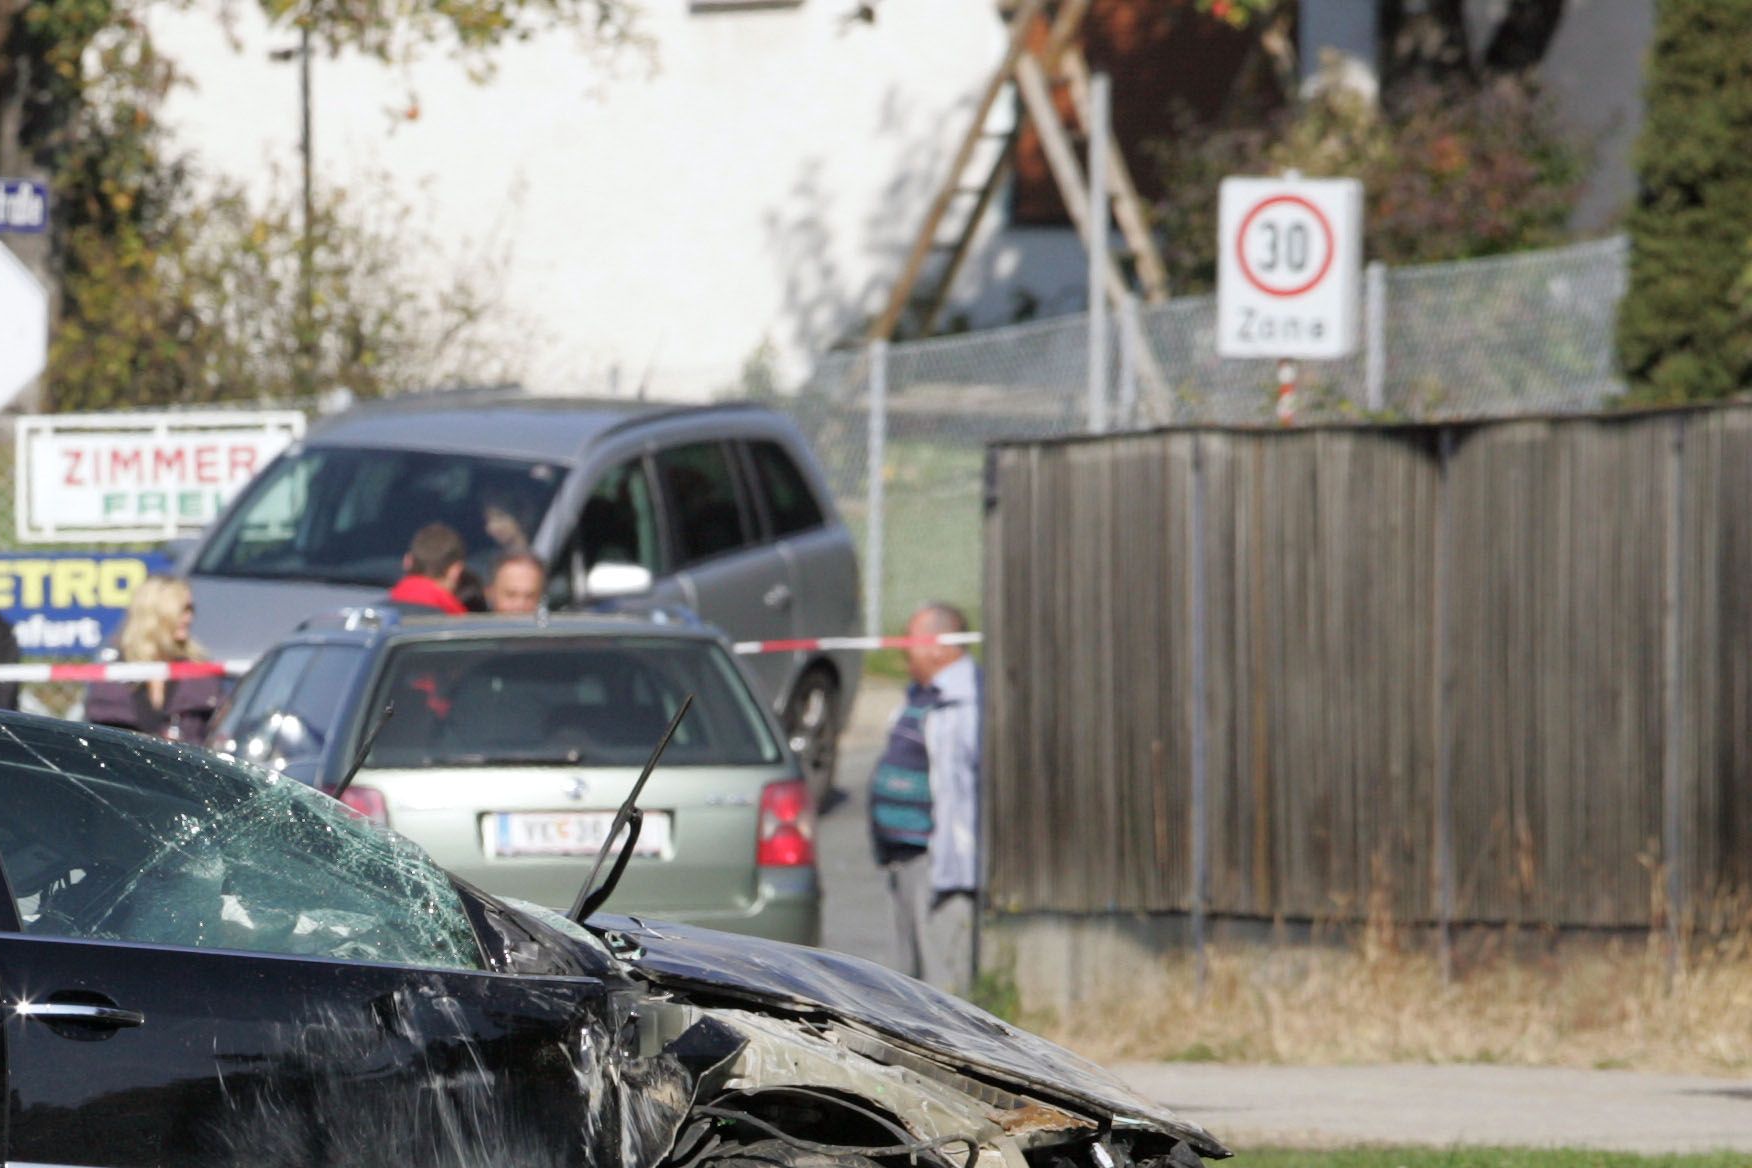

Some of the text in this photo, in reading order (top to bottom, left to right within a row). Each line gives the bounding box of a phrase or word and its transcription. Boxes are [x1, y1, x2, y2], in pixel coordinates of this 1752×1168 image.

[1257, 220, 1309, 272] 30
[1237, 305, 1325, 341] Zone
[62, 445, 259, 487] ZIMMER
